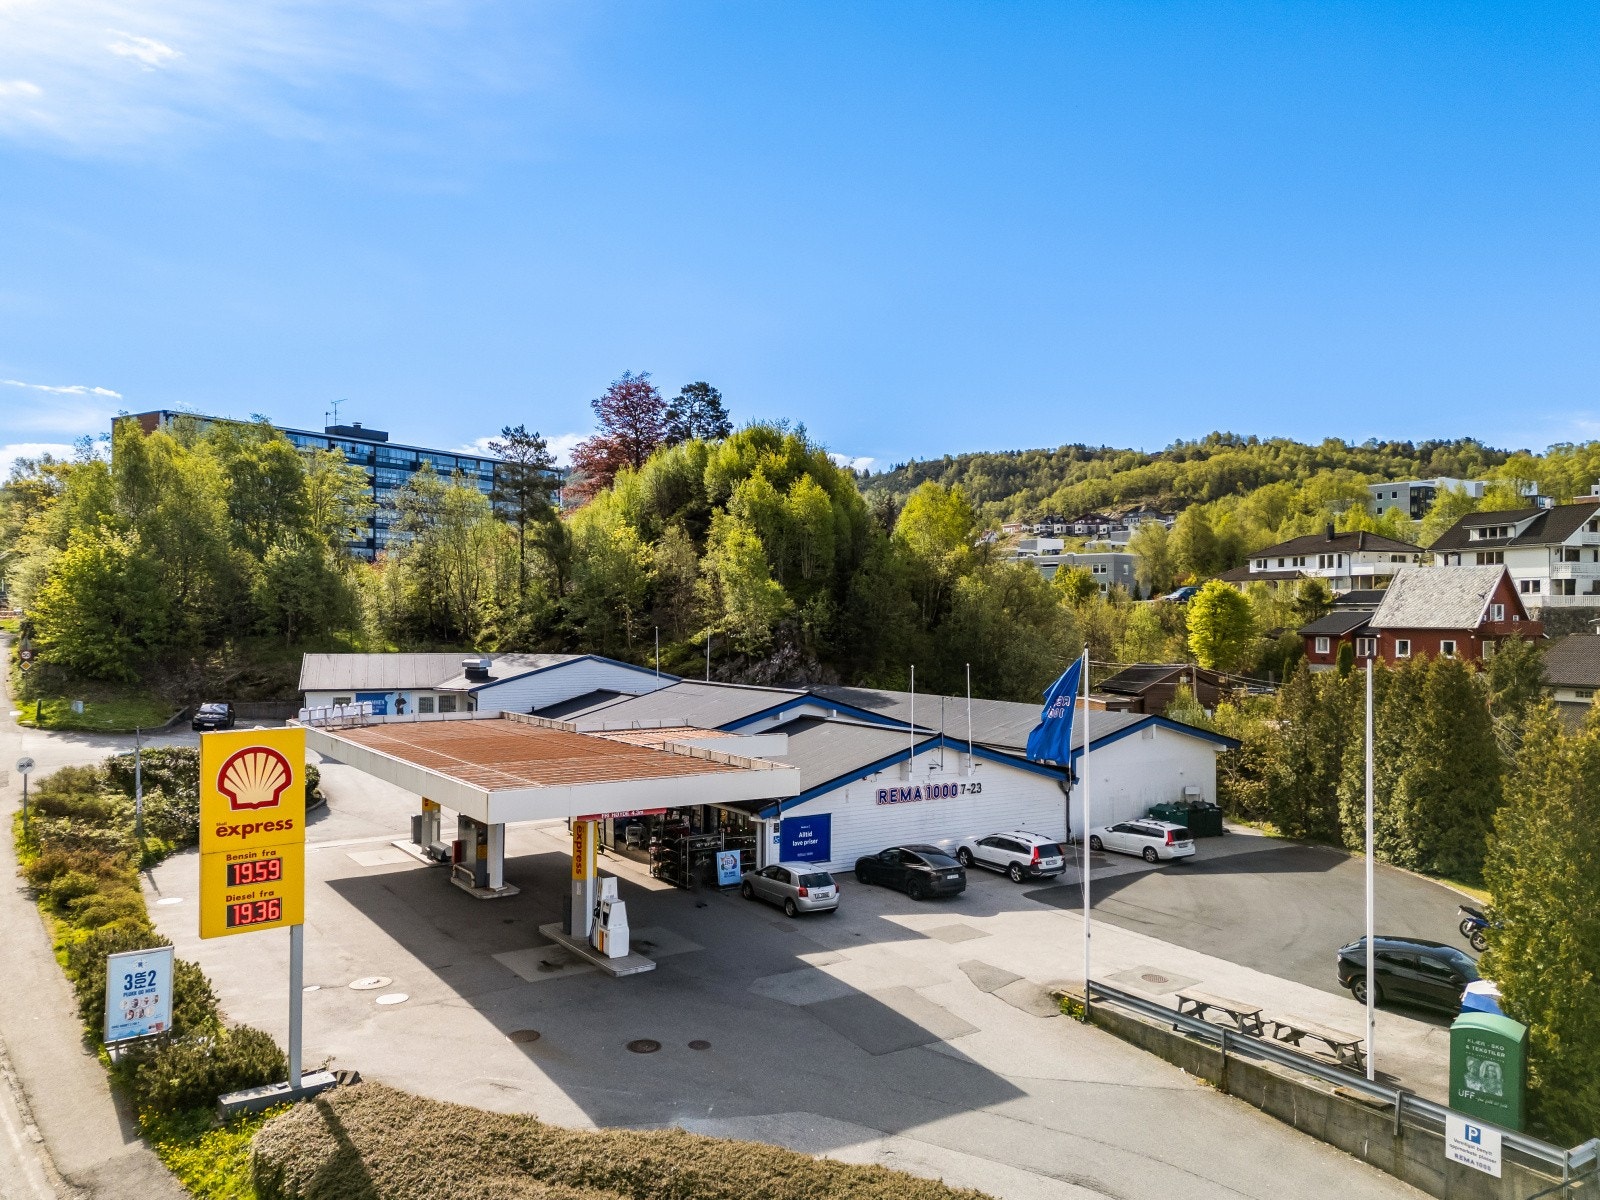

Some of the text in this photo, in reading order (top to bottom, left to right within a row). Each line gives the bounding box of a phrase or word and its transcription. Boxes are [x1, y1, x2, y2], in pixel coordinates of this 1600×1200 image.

[876, 783, 958, 805] REMA 1000
[960, 782, 982, 794] 7-23
[216, 819, 294, 839] express
[226, 851, 257, 862] Bensin
[233, 860, 280, 885] 19.59
[226, 892, 255, 902] Diesel
[233, 900, 280, 926] 19.36
[124, 970, 156, 990] 3 FOR 2
[1458, 1088, 1476, 1099] UFF
[1469, 1126, 1478, 1140] P
[1454, 1153, 1475, 1166] REMA
